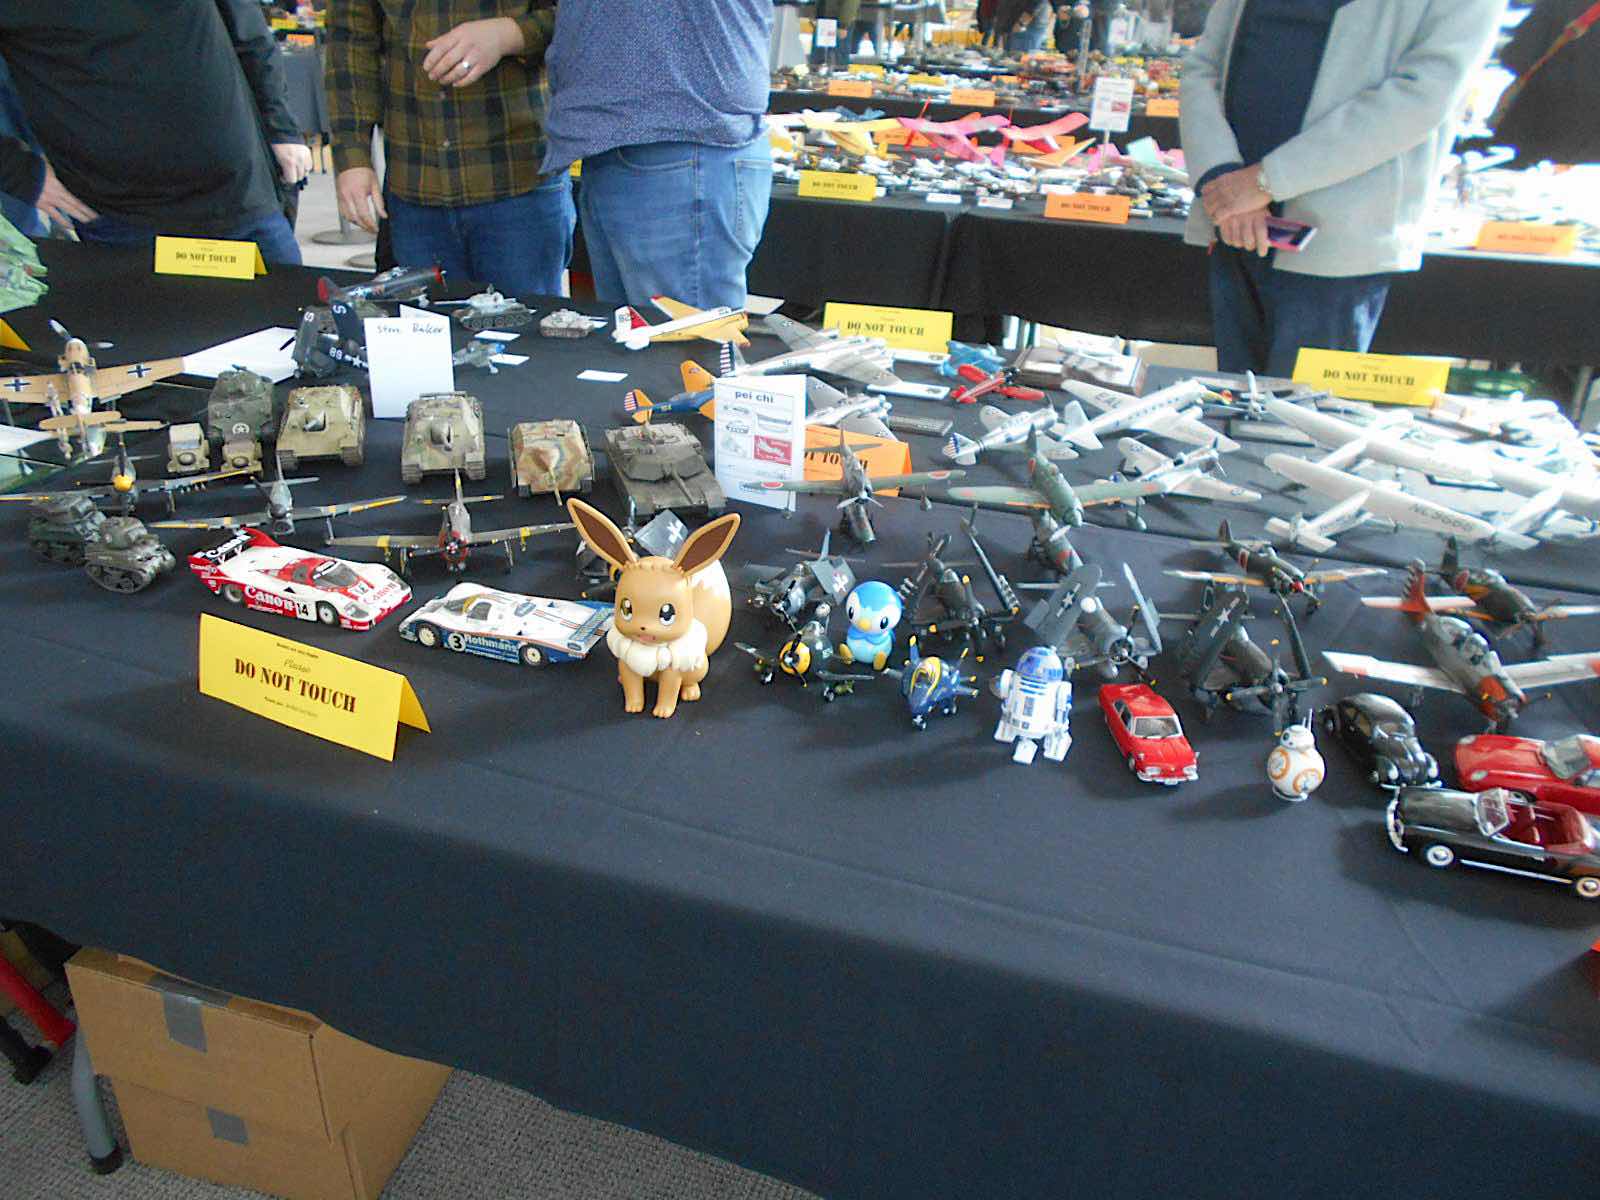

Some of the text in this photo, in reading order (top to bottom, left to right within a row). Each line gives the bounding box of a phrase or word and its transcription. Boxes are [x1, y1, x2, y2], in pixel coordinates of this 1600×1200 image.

[175, 251, 237, 264] DO NOT TOUCH
[847, 320, 925, 337] DO NOT TOUCH
[1322, 368, 1416, 386] DO NOT TOUCH
[735, 391, 774, 404] pei chi
[244, 583, 297, 612] Canon
[452, 634, 518, 652] 3 Rothmans
[235, 658, 256, 679] DO
[259, 667, 295, 692] NOT
[298, 679, 357, 713] TOUCH
